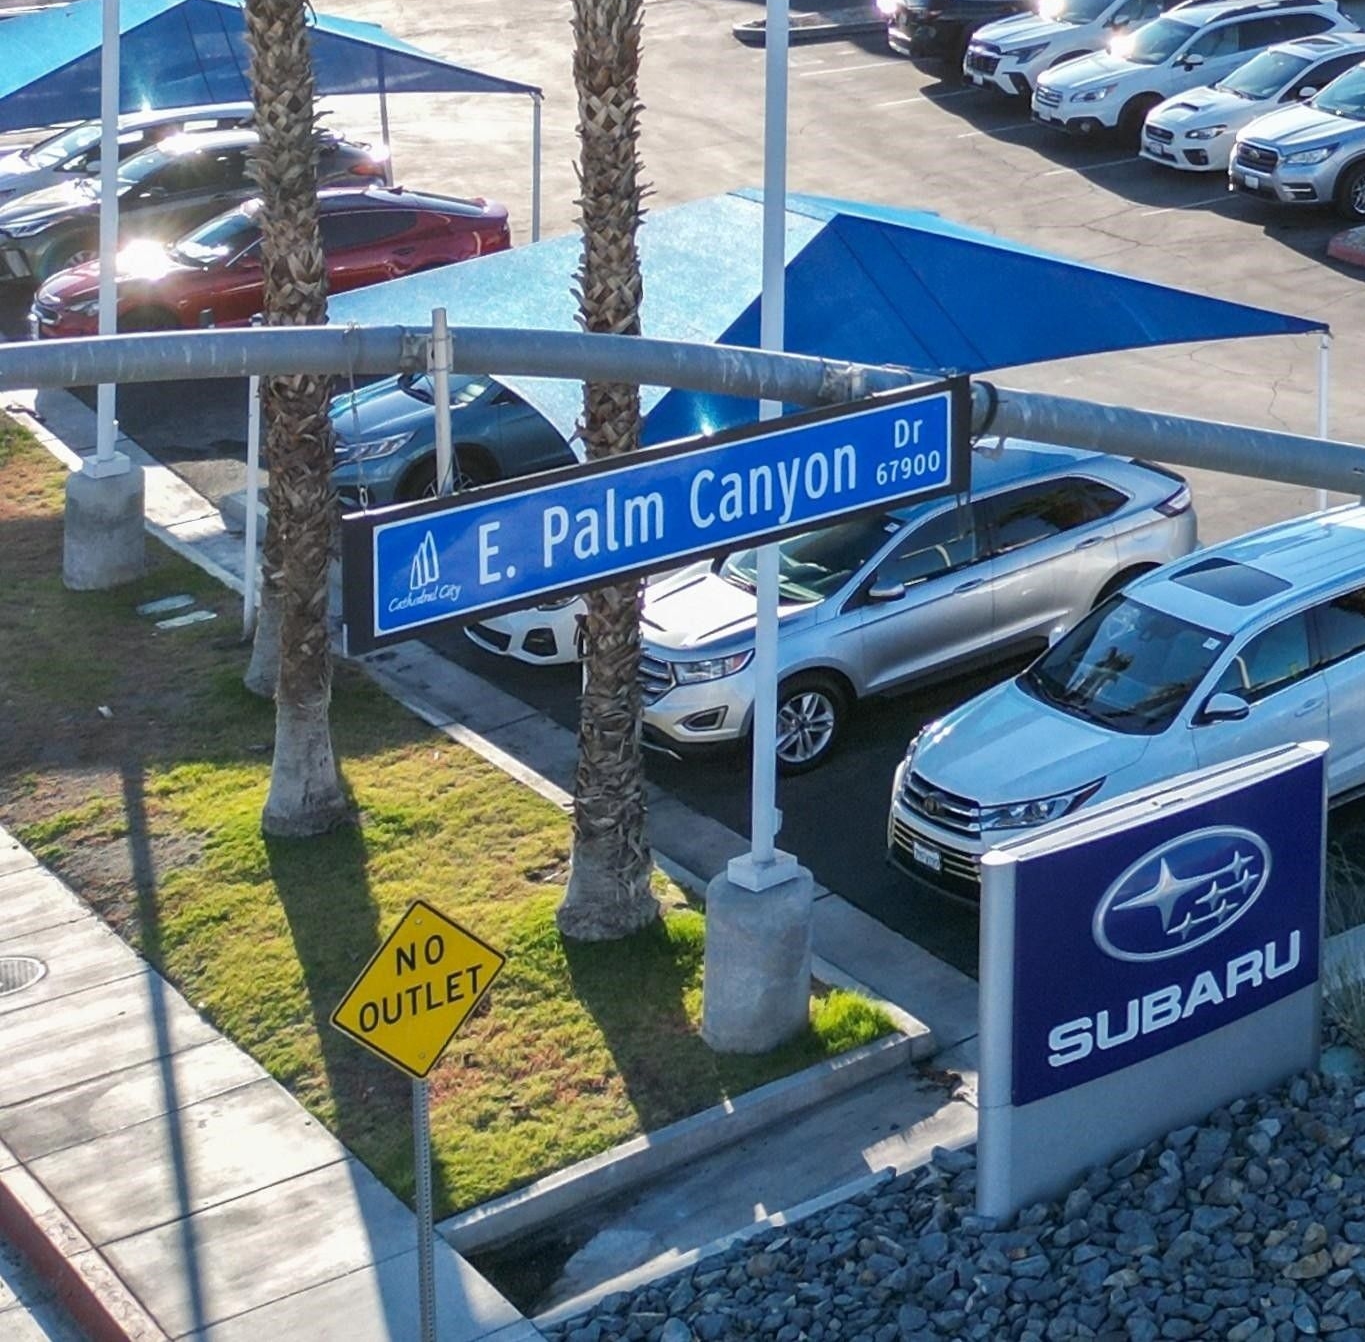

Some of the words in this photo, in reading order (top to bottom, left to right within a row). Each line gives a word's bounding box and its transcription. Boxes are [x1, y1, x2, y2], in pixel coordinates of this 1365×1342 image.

[876, 449, 940, 486] 67900
[478, 521, 516, 585] E.
[543, 488, 664, 568] Palm
[689, 444, 857, 529] Canyon
[894, 419, 923, 449] Dr
[439, 584, 461, 602] City
[396, 934, 445, 976] NO
[359, 964, 483, 1033] OUTLET
[1048, 929, 1301, 1068] SUBARU
